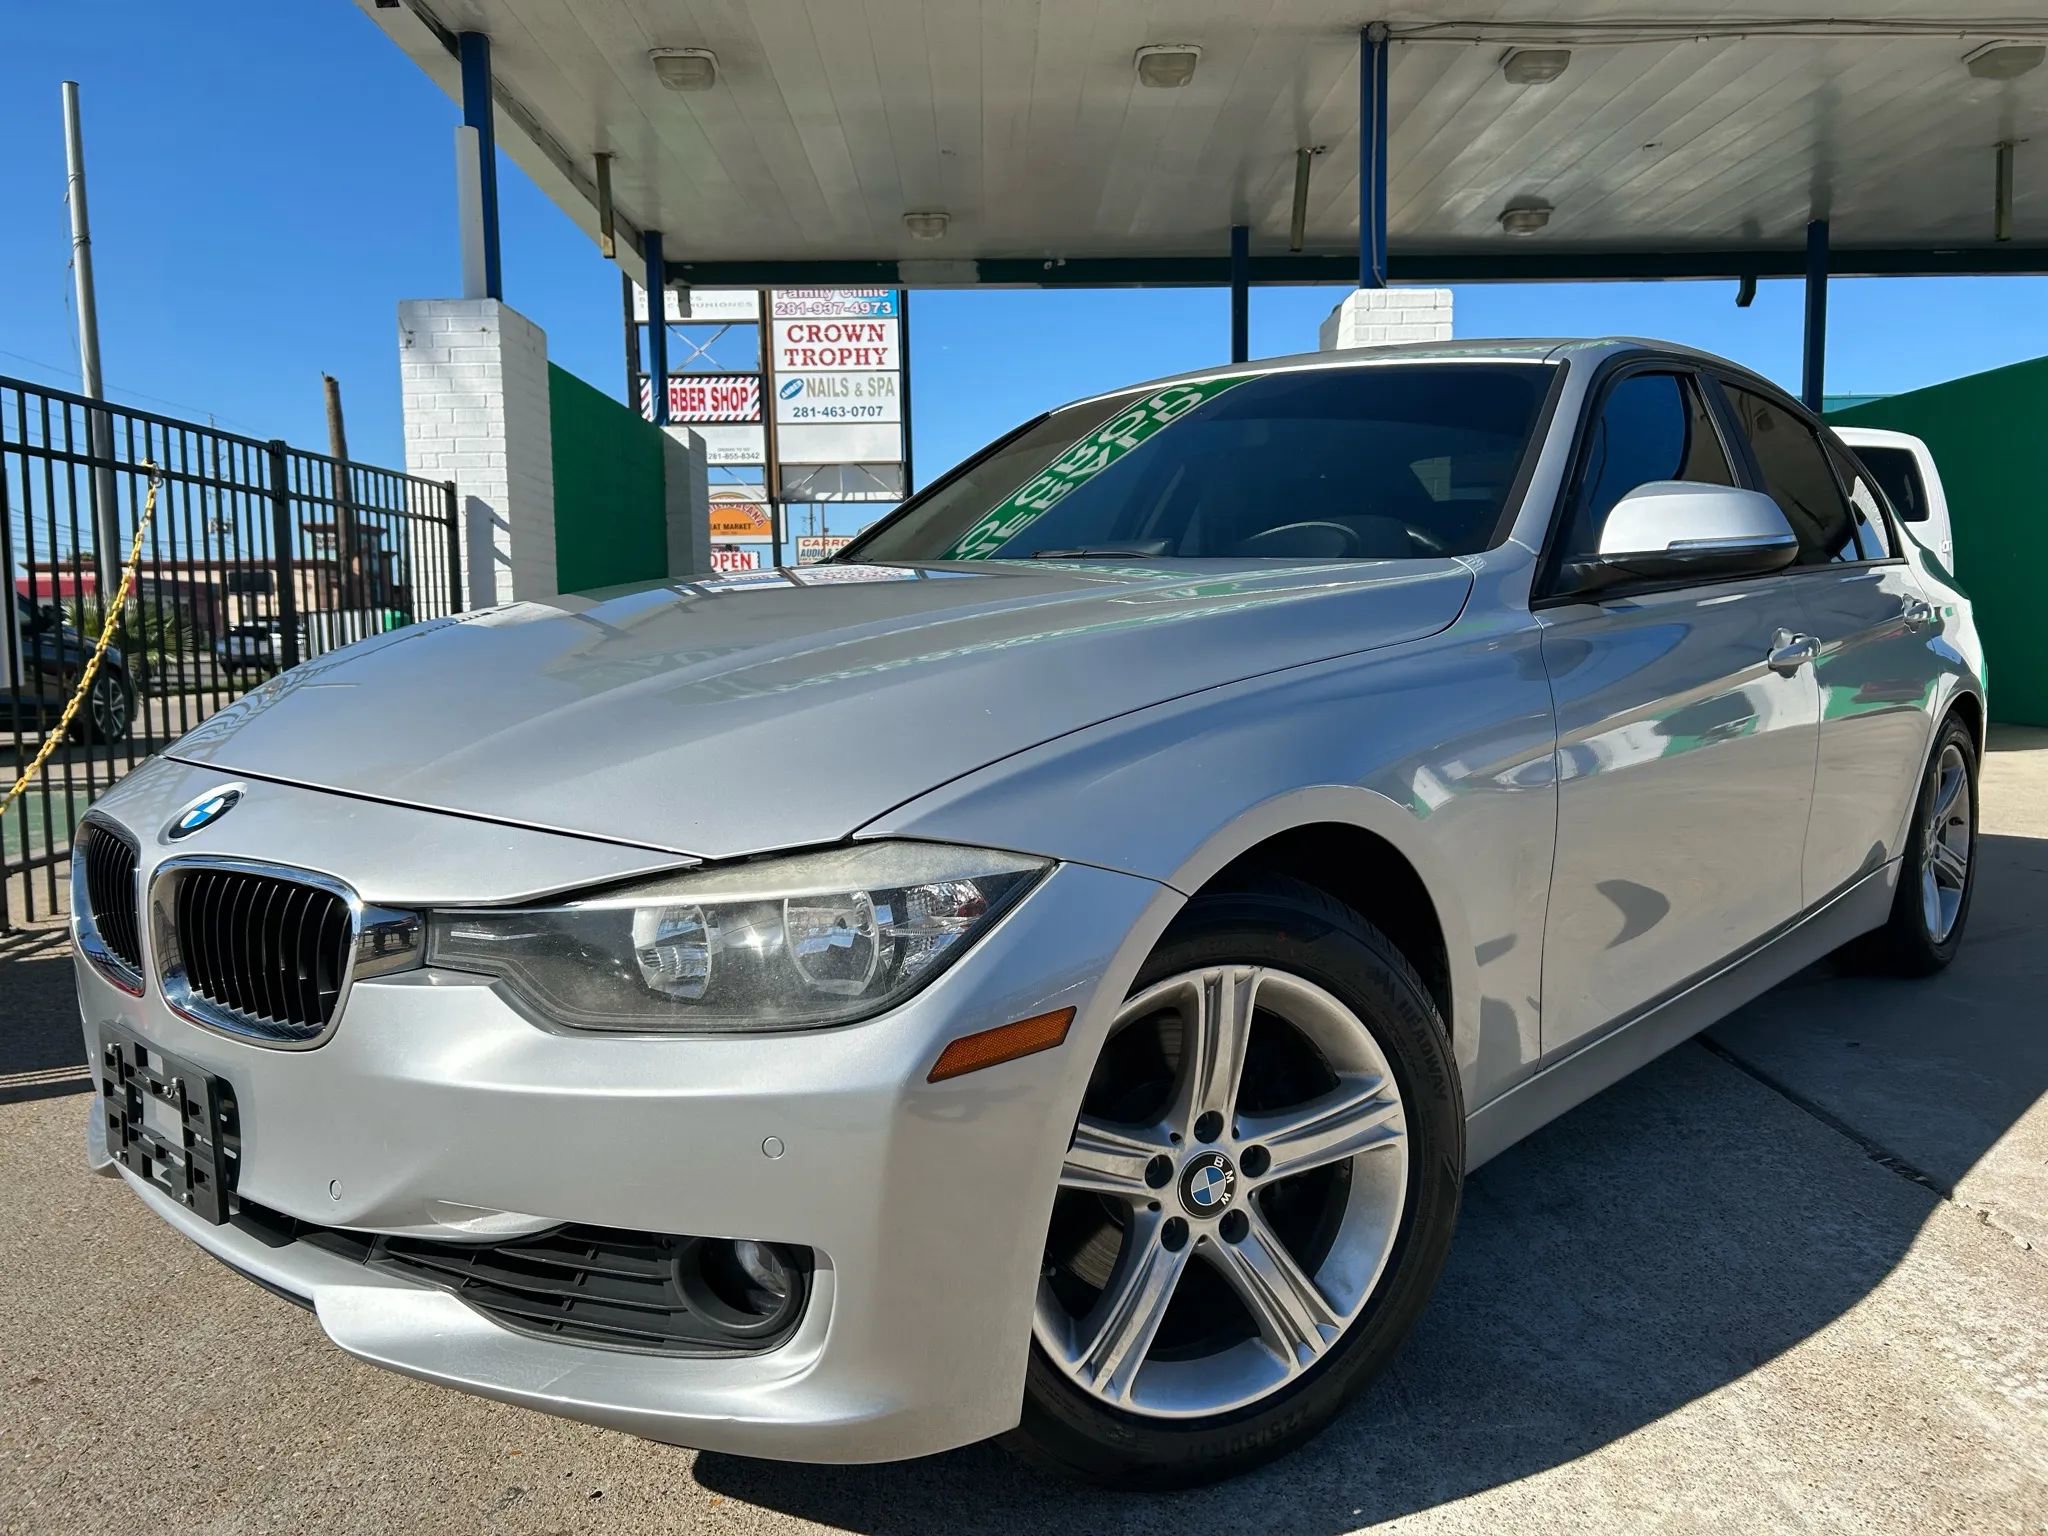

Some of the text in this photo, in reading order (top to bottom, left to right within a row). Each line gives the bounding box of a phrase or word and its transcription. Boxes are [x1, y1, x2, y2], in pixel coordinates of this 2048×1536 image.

[776, 289, 889, 301] Family Clinic
[775, 301, 892, 315] 281-937-4973
[786, 324, 886, 343] CROWN
[784, 348, 888, 366] TROPHY
[806, 378, 849, 398] NAILS
[855, 383, 863, 397] &
[868, 377, 895, 397] SPA
[711, 386, 748, 412] SHOP
[793, 406, 884, 418] 281-463-0707
[801, 548, 826, 557] AUDIO
